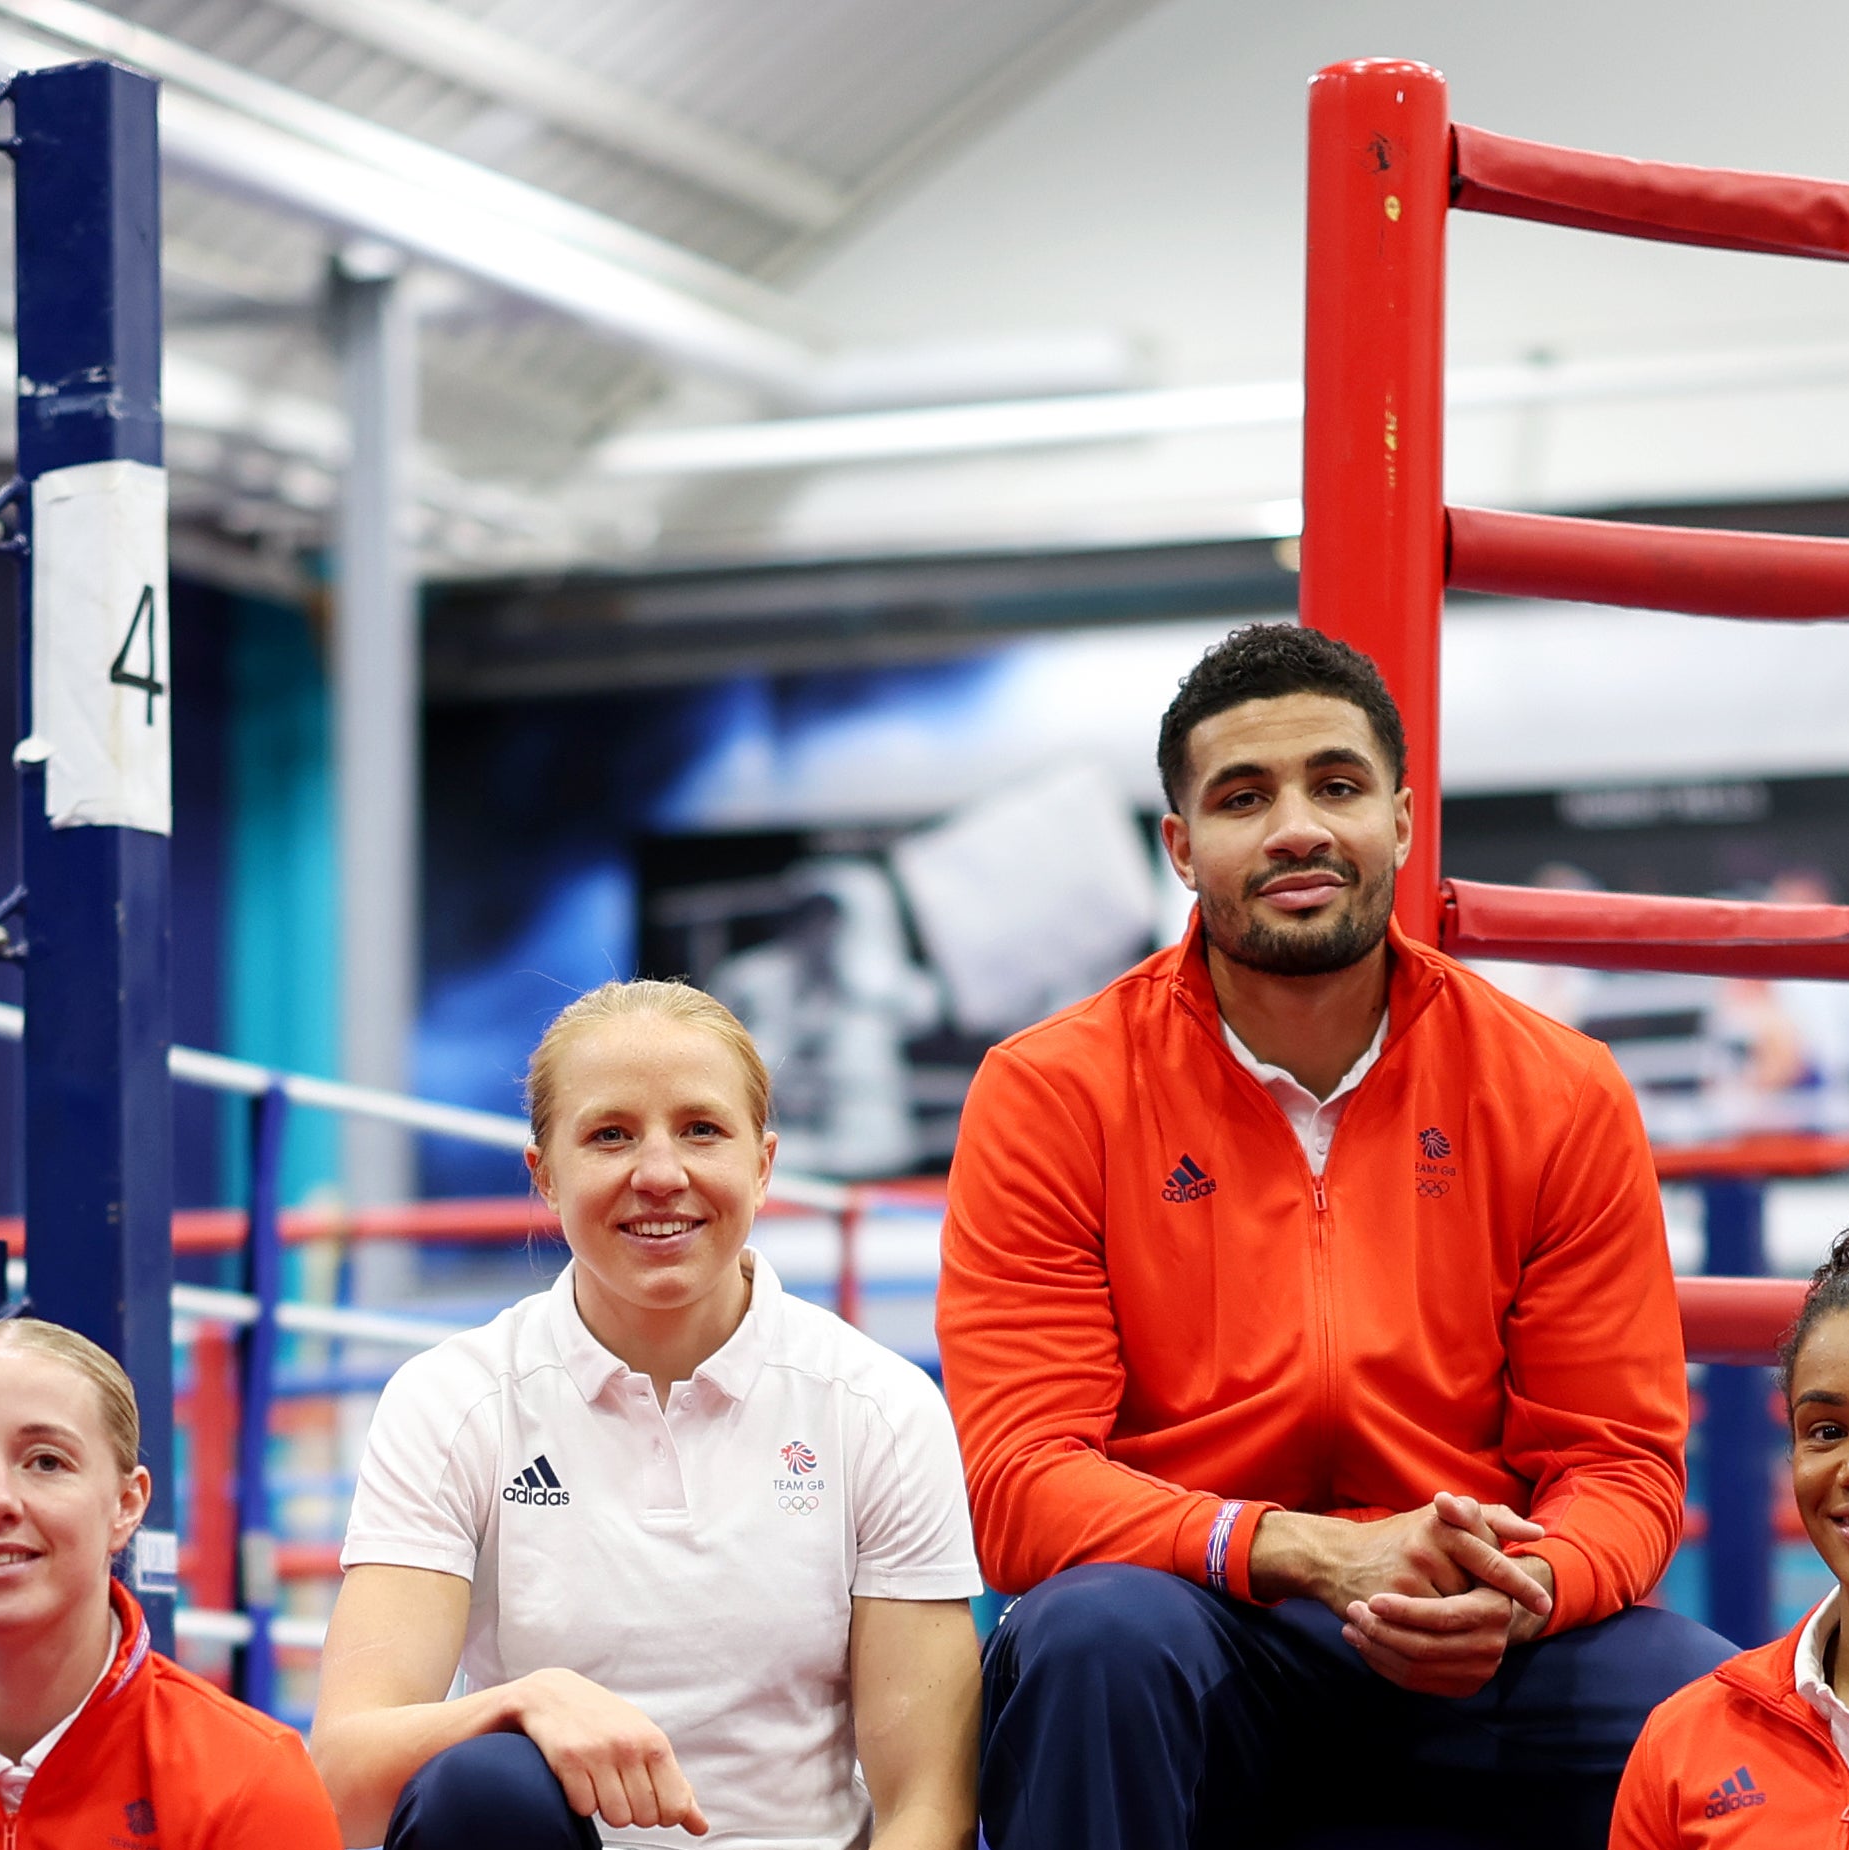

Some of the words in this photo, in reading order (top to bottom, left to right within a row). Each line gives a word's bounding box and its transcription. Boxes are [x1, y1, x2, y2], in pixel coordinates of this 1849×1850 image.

[109, 584, 164, 727] 4
[1161, 1178, 1217, 1203] adidas
[502, 1486, 570, 1506] adidas
[773, 1480, 804, 1491] TEAM
[807, 1480, 825, 1491] GB
[1704, 1792, 1766, 1819] adidas
